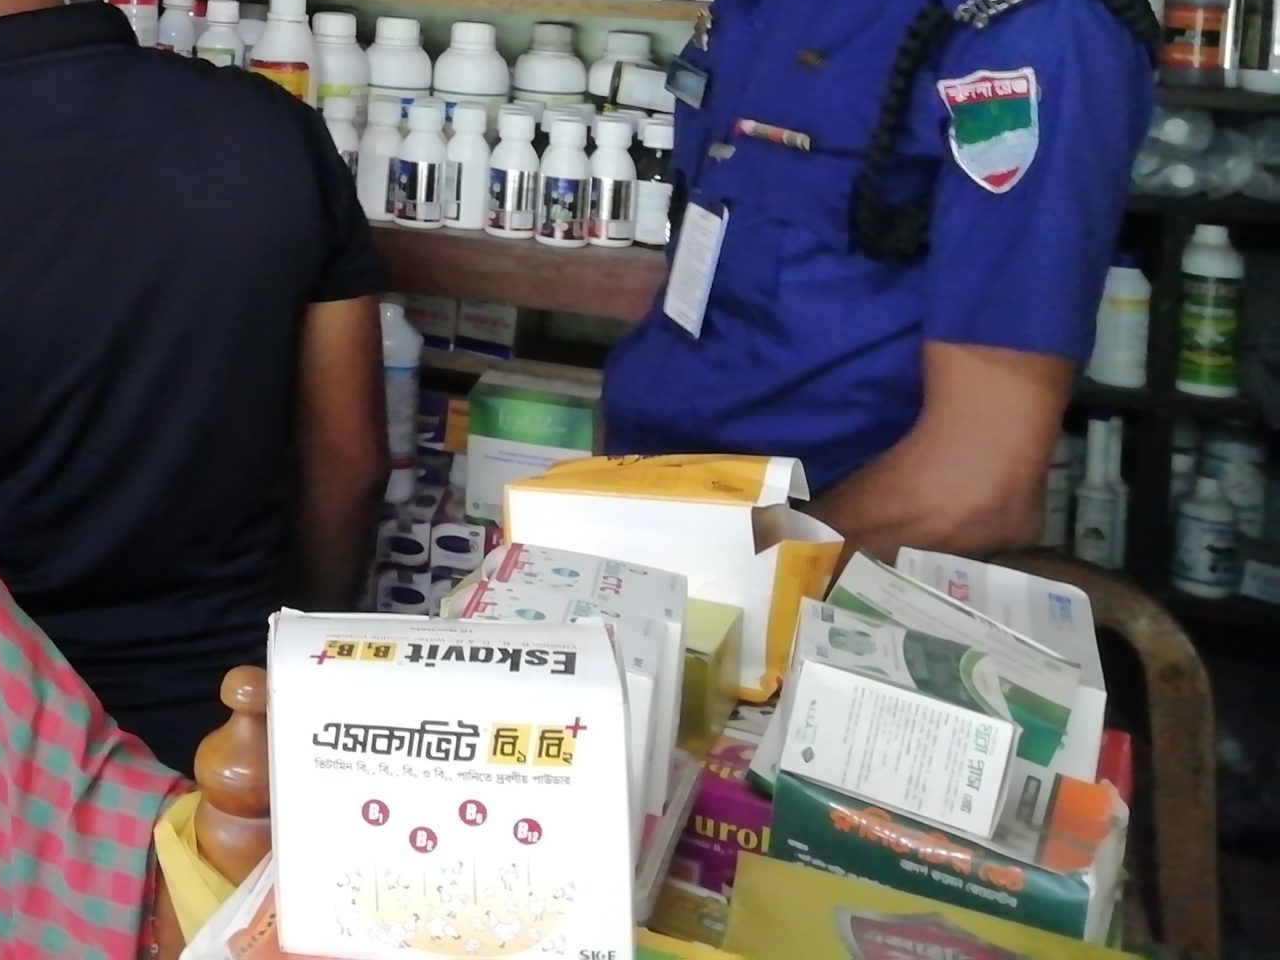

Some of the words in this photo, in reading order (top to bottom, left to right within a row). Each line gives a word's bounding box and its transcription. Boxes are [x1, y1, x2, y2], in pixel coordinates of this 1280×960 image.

[404, 643, 577, 675] Eskavit
[312, 720, 480, 761] এসকাভিট
[695, 815, 771, 854] urol
